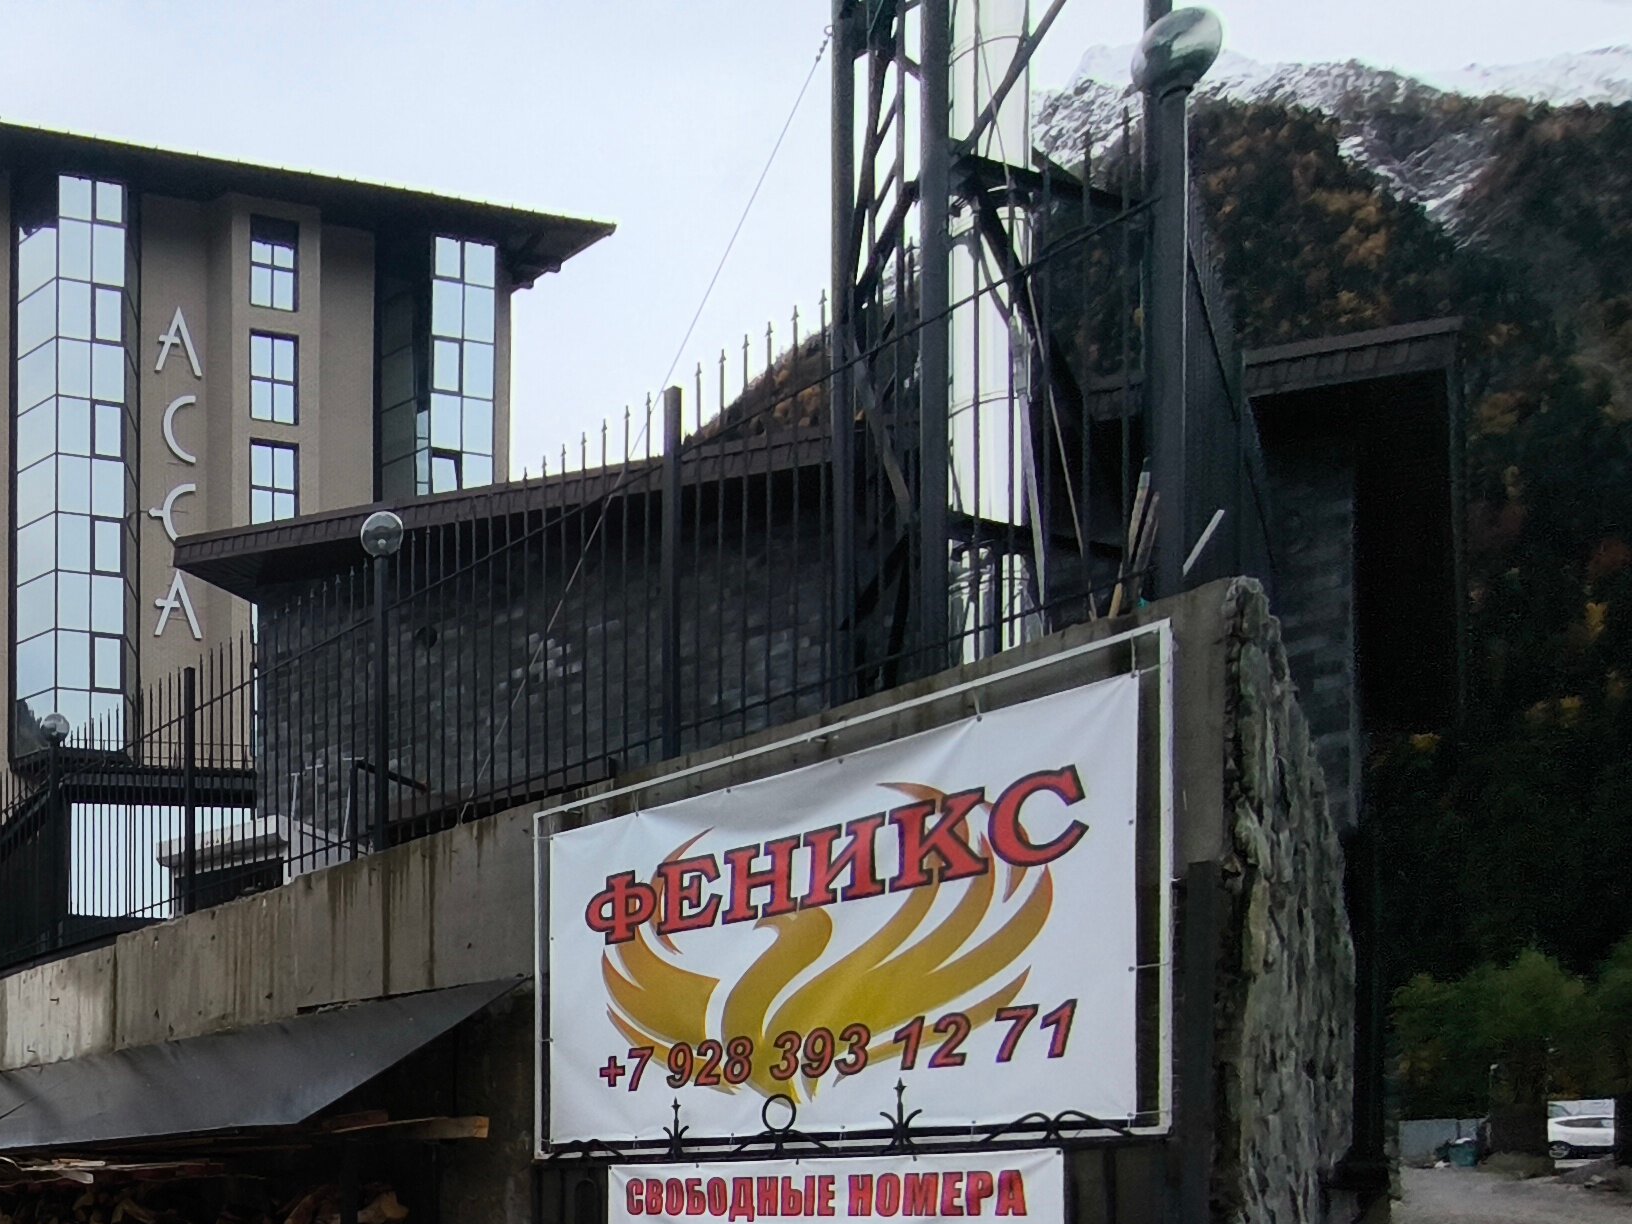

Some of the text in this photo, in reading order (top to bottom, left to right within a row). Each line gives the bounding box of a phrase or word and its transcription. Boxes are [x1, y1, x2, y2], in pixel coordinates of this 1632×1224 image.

[585, 764, 1089, 946] ФЕНИКС
[598, 998, 1079, 1092] +7 928 393 12 71
[625, 1169, 1028, 1223] СВОБОДНЫЕ НОМЕРА
